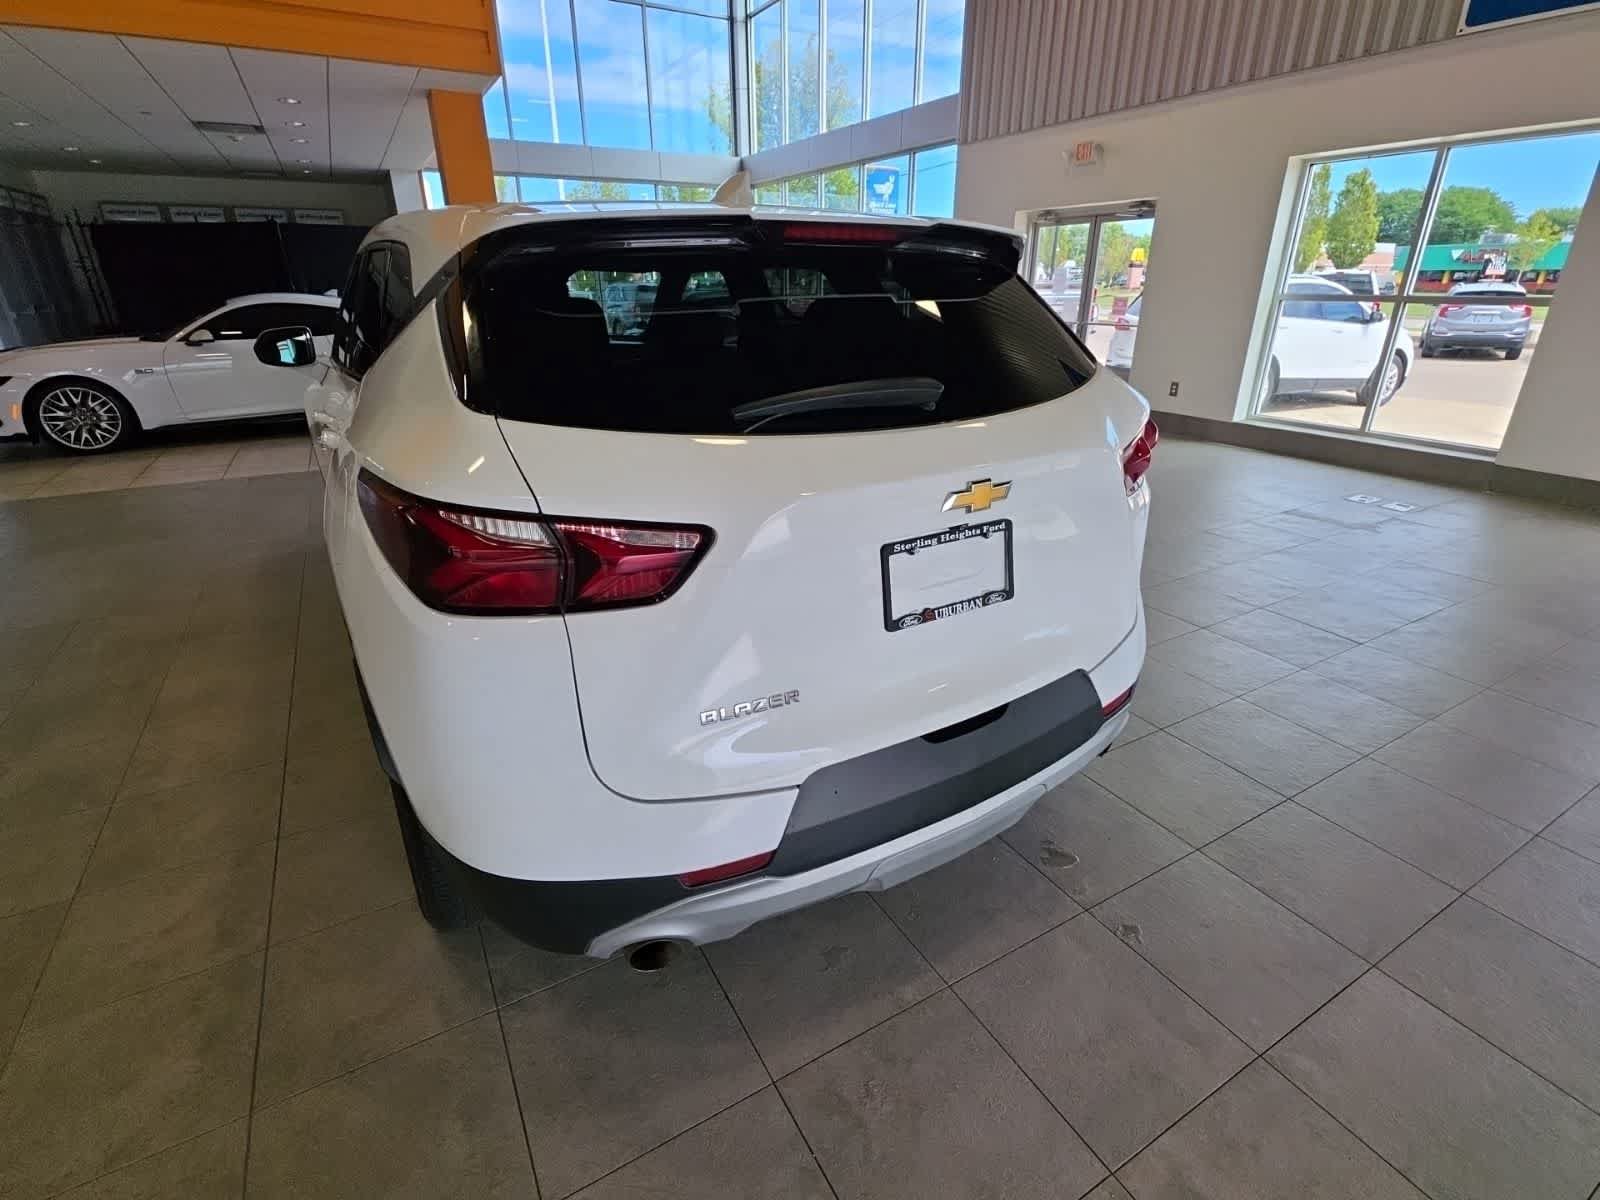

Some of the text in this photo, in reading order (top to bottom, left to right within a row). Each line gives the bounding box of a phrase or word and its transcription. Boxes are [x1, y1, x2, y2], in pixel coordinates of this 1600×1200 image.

[893, 521, 1006, 553] Sterling Heights Ford
[700, 689, 799, 726] BLAZER
